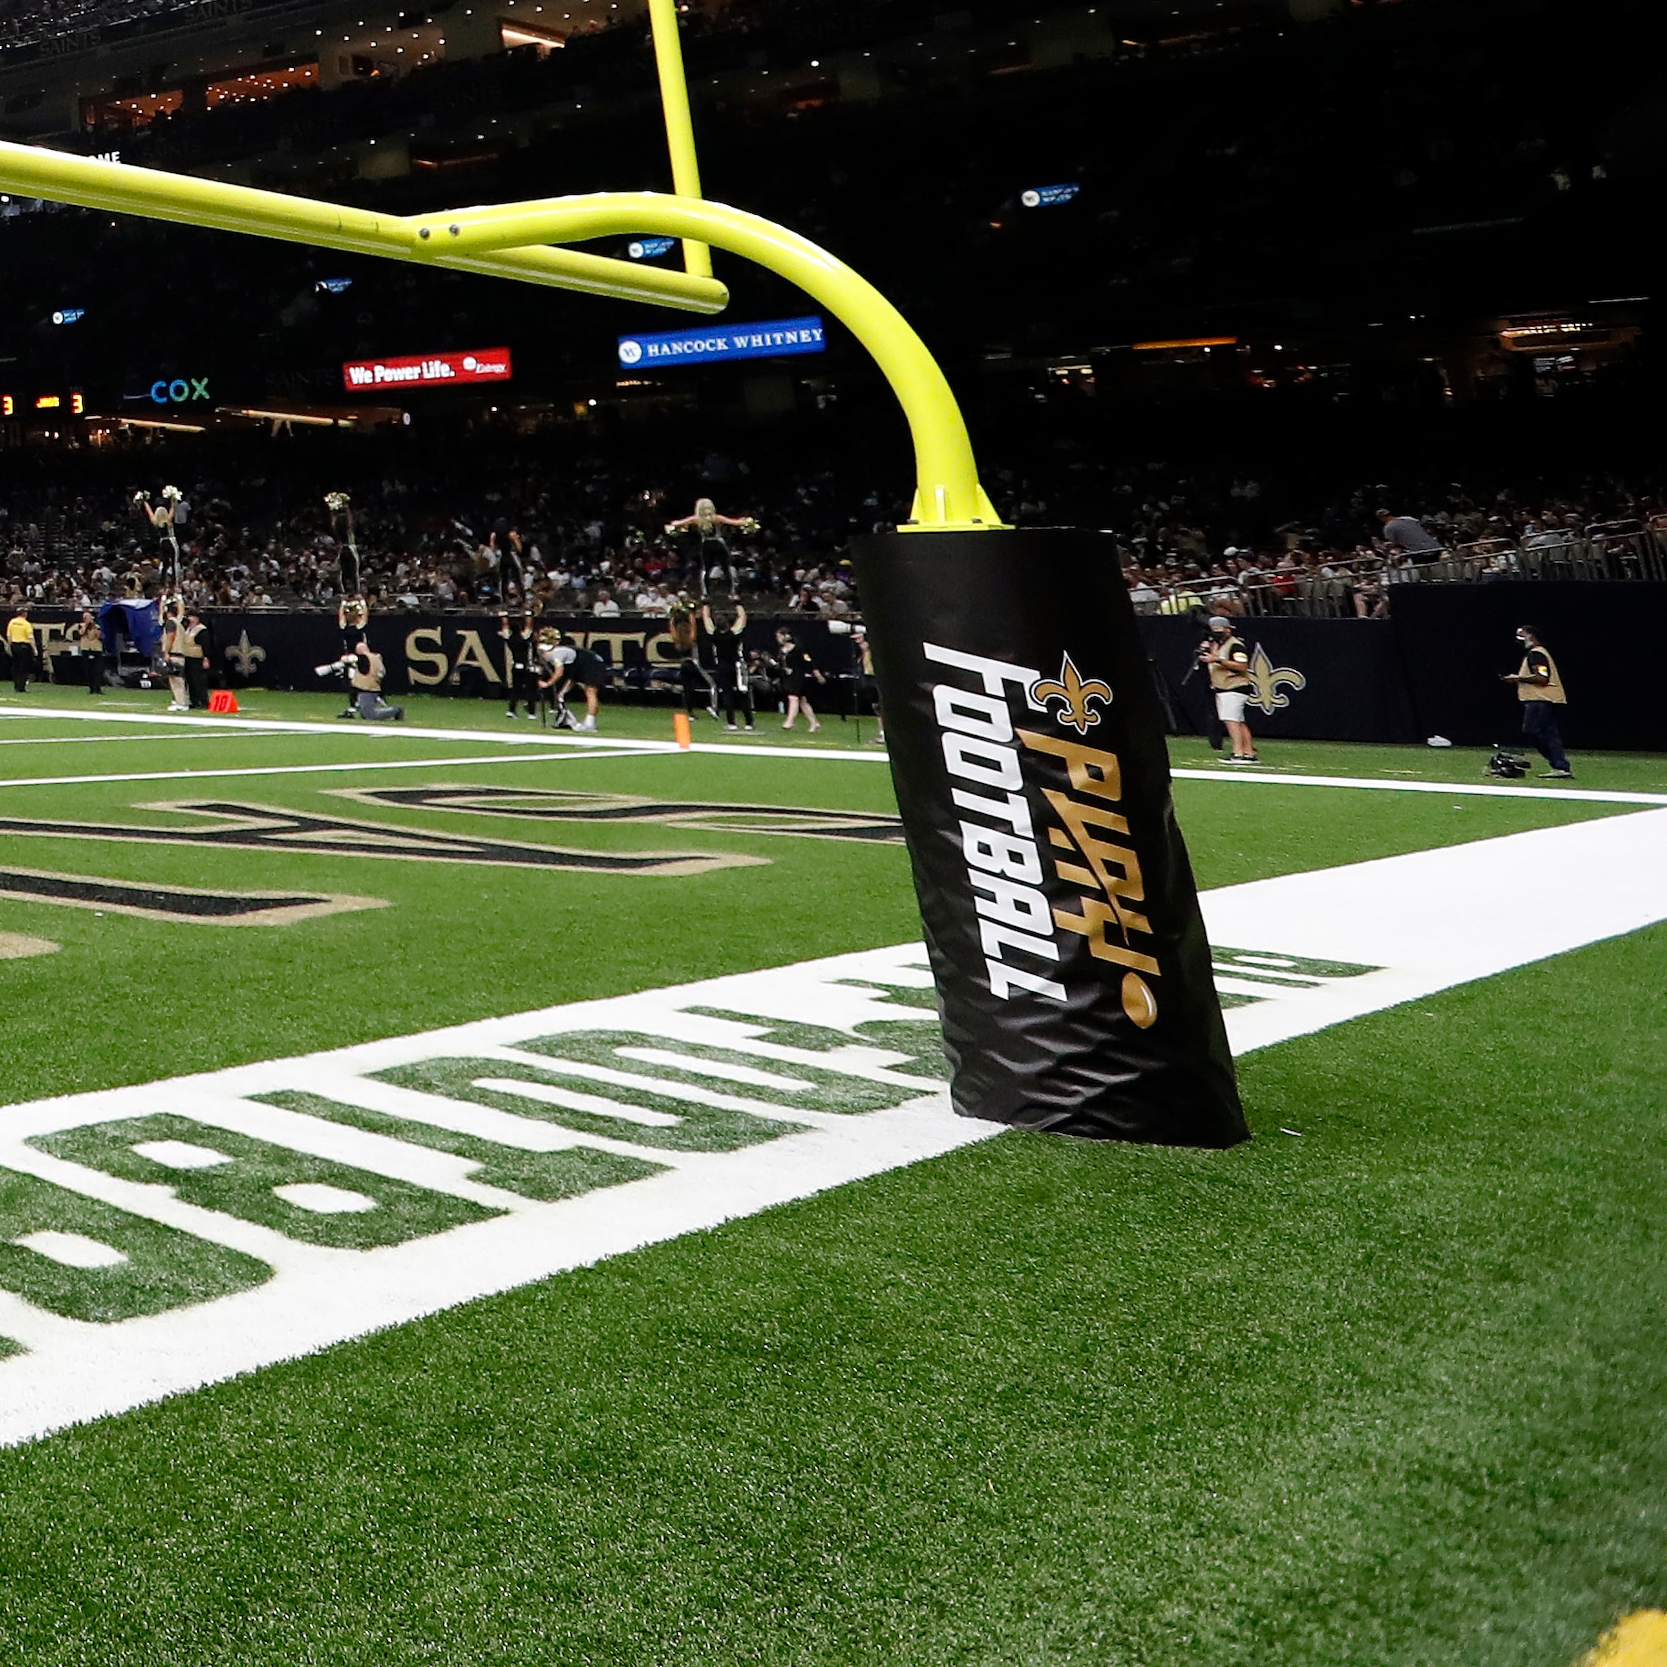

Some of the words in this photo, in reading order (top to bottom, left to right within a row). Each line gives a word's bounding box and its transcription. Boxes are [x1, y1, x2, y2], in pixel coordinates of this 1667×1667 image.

[647, 338, 728, 357] HANCOCK
[733, 328, 823, 349] WHITNEY
[349, 366, 373, 384] We
[373, 364, 420, 384] Power
[422, 360, 455, 379] Life.
[150, 377, 211, 403] COX
[2, 395, 14, 416] 3
[72, 393, 84, 414] 3
[214, 694, 229, 708] 10
[921, 640, 1067, 1001] FOOTBALL
[1016, 727, 1162, 976] PLAY
